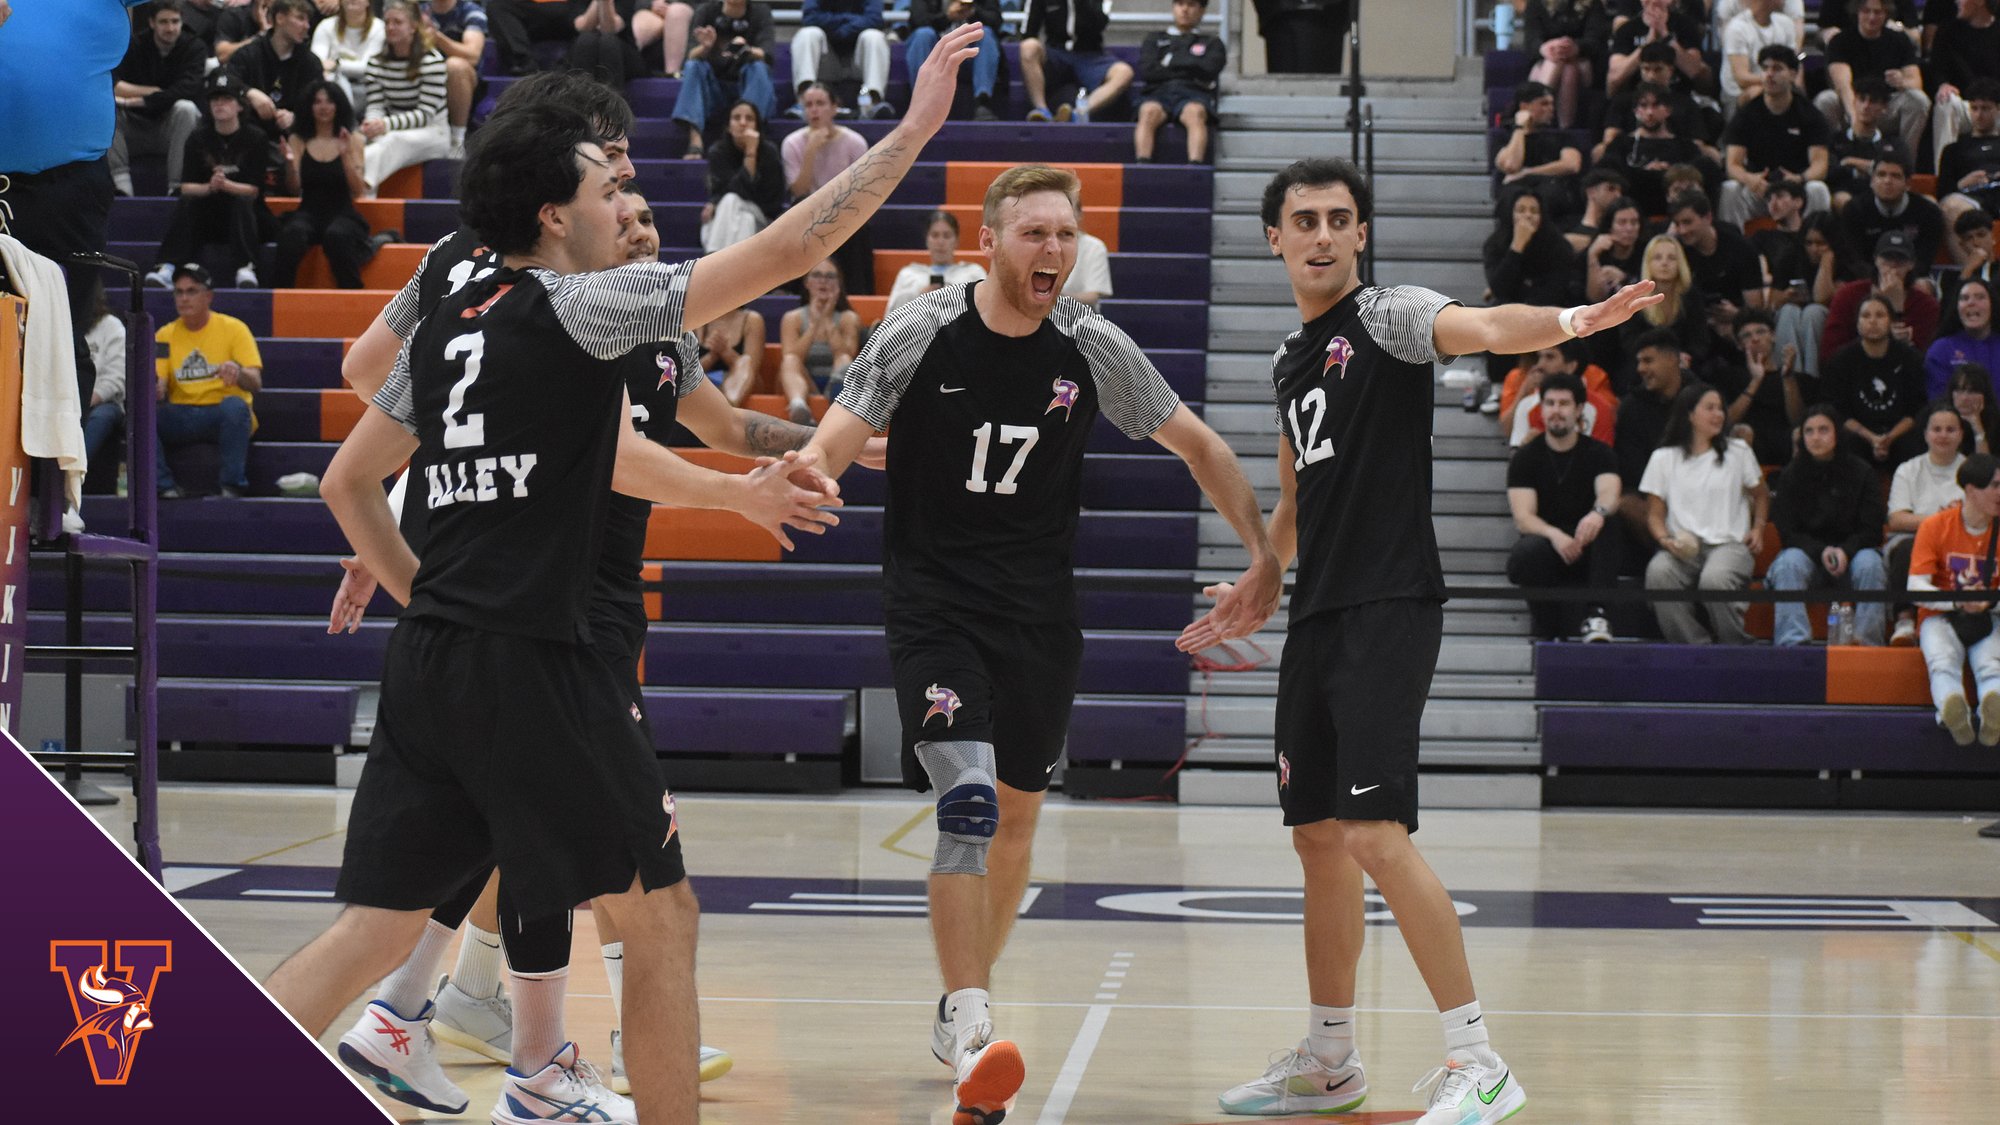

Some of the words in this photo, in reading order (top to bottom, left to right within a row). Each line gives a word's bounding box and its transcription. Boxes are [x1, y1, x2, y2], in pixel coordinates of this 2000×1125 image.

[442, 330, 485, 449] 2
[966, 422, 1039, 494] 17
[1288, 387, 1335, 472] 12
[425, 453, 538, 509] ALLEY
